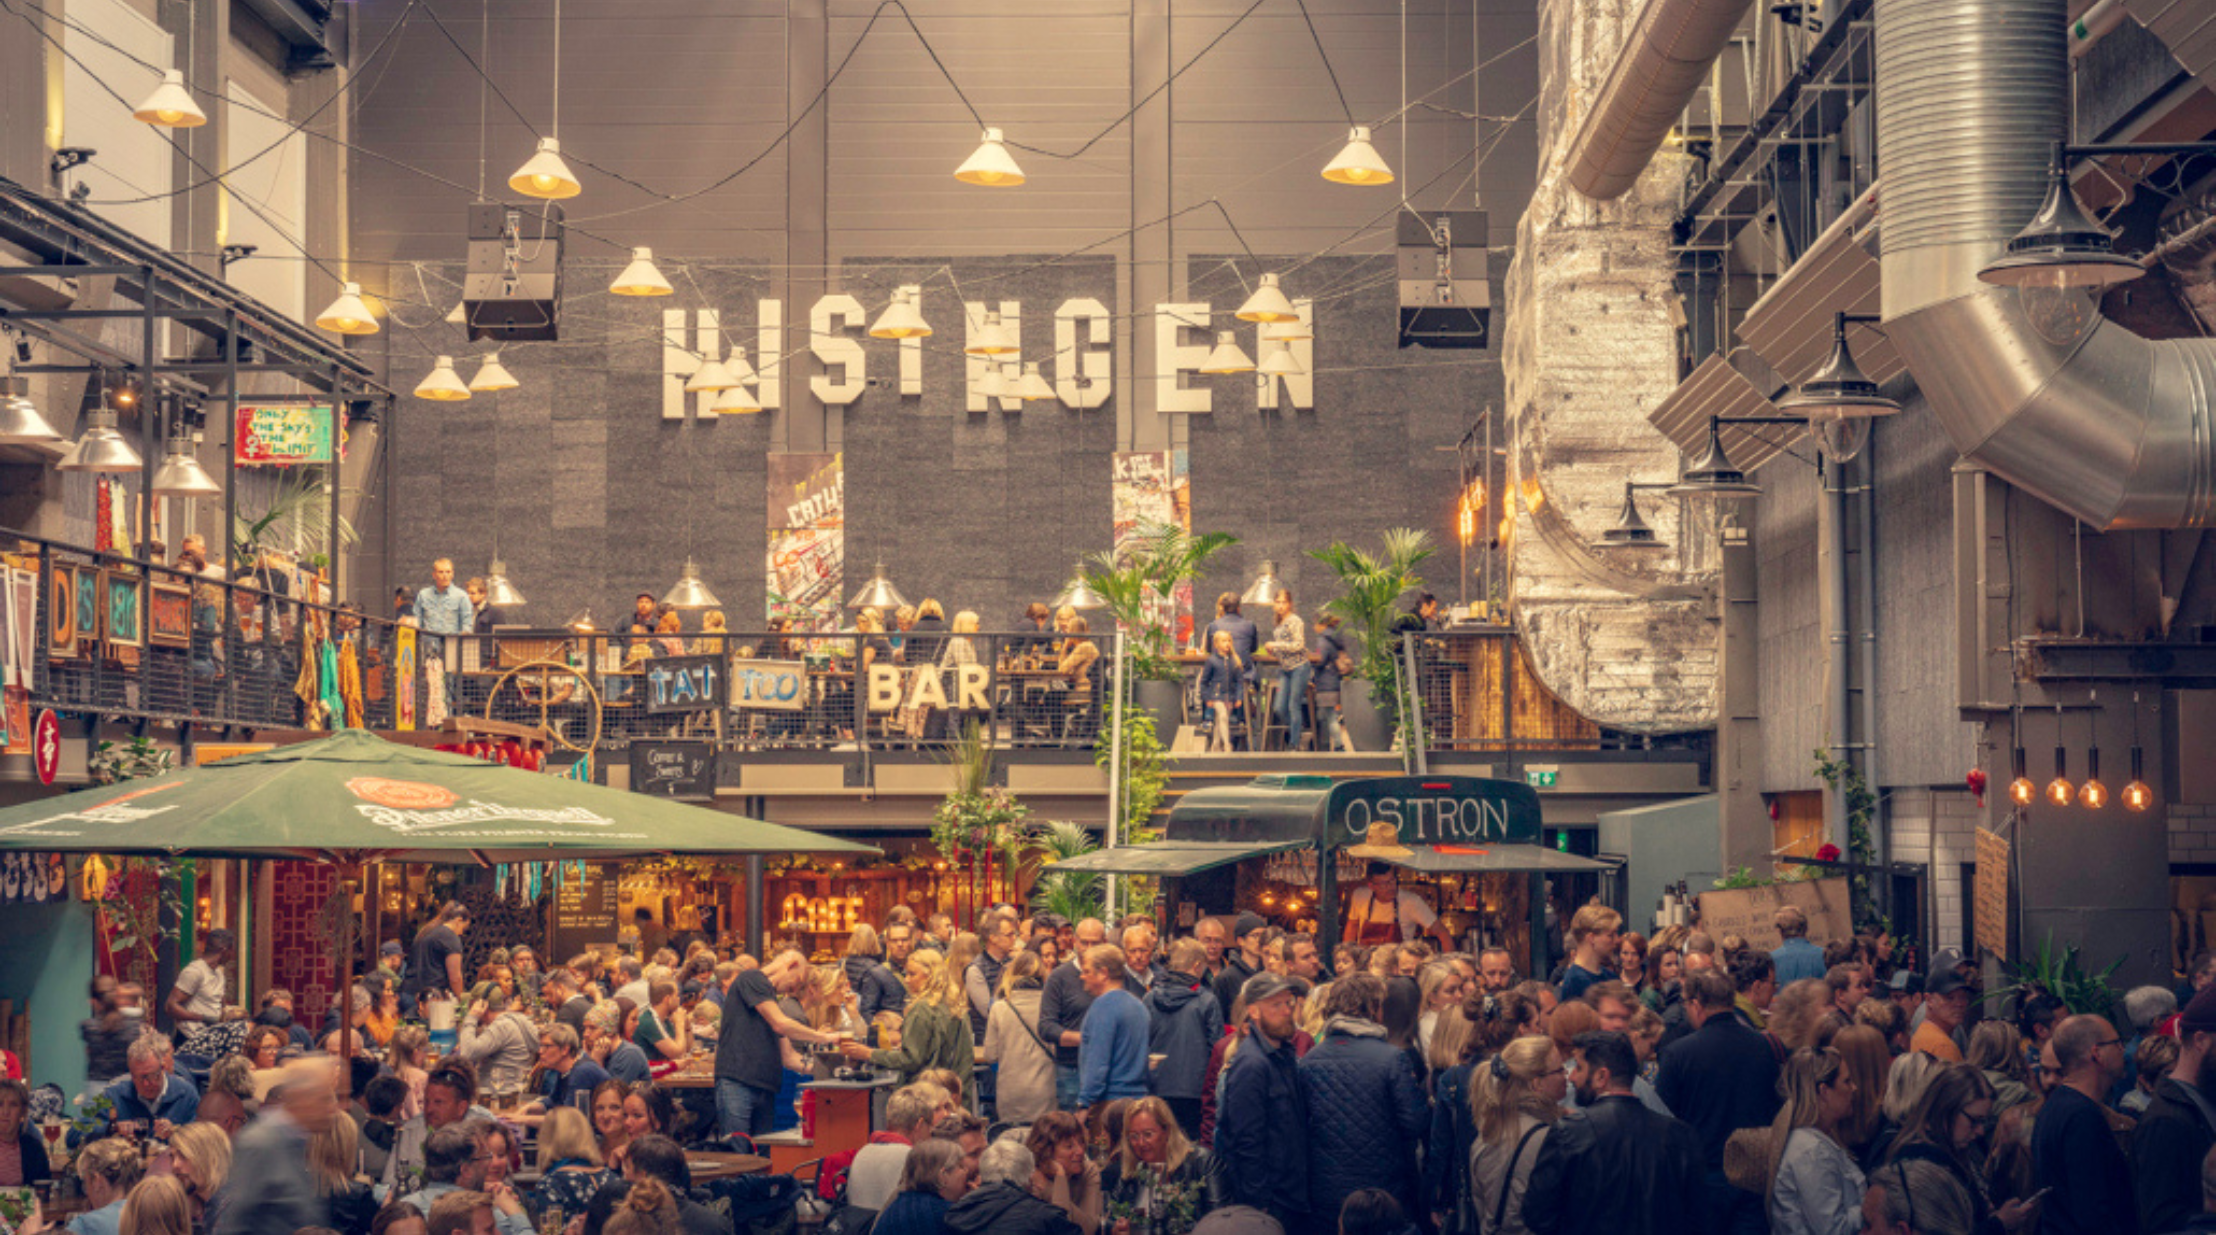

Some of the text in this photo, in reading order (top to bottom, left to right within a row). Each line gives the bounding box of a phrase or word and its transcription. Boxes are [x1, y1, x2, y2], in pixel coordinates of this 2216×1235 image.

[252, 422, 274, 432] THE
[256, 408, 288, 419] ONLY
[260, 434, 284, 442] THE
[273, 443, 315, 455] LIMIT
[649, 664, 717, 704] TAT
[738, 668, 799, 702] TOO
[868, 662, 991, 710] BAR
[1345, 797, 1509, 839] OSTRON
[783, 892, 863, 934] CAFE
